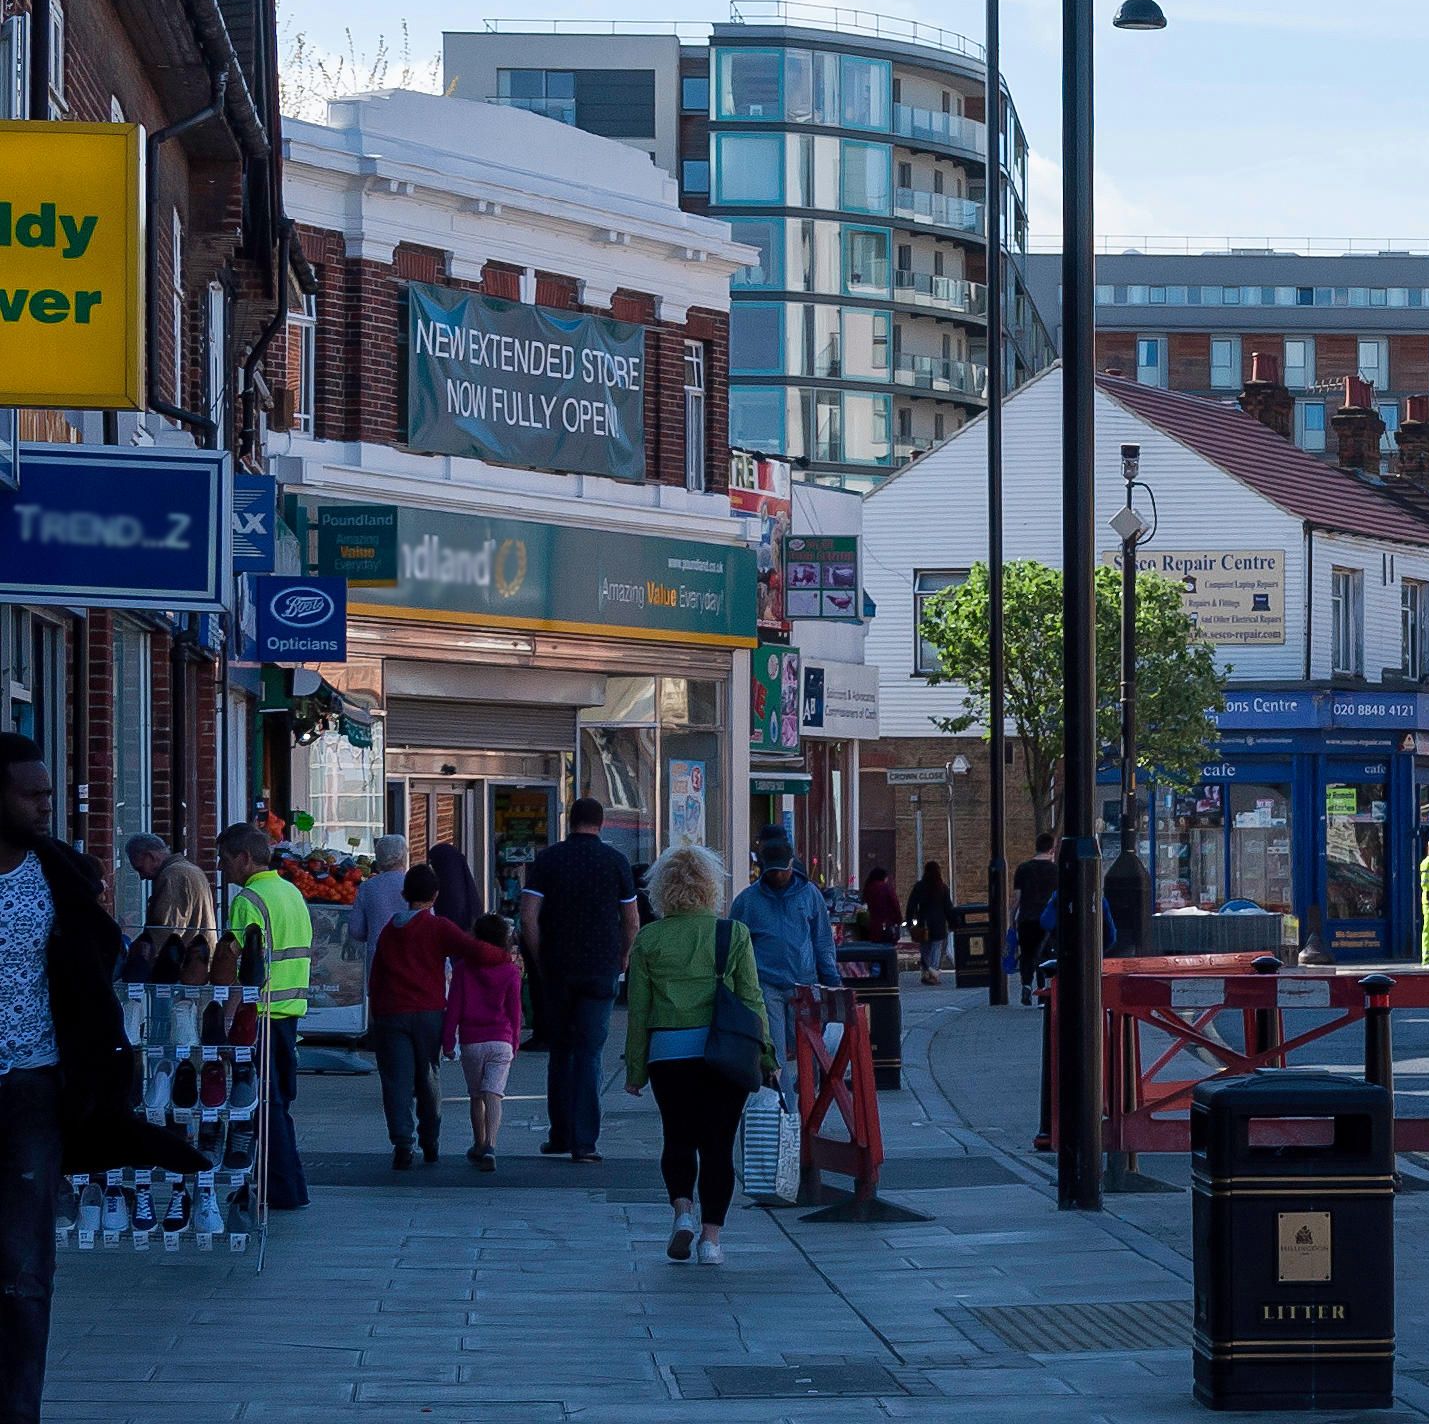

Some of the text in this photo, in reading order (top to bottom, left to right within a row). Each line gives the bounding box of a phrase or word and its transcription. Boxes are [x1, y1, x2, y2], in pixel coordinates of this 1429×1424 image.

[416, 319, 640, 391] NEW EXTENDED STORE
[447, 378, 487, 419] NOW
[492, 387, 557, 429] FULLY
[322, 514, 393, 527] Poundland
[336, 534, 379, 547] Amazing
[1114, 553, 1276, 576] Ssco Repair Centre
[600, 577, 645, 610] Amazing
[647, 580, 678, 608] Value
[284, 595, 326, 618] Boots
[267, 636, 338, 652] Opticians
[1253, 697, 1298, 713] Centre
[1333, 703, 1354, 716] 020
[1358, 704, 1385, 716] 8848
[1389, 704, 1414, 717] 4121
[890, 772, 945, 781] CROWN CLOSE
[1364, 763, 1387, 775] cafe
[1264, 1305, 1345, 1319] LITTER
